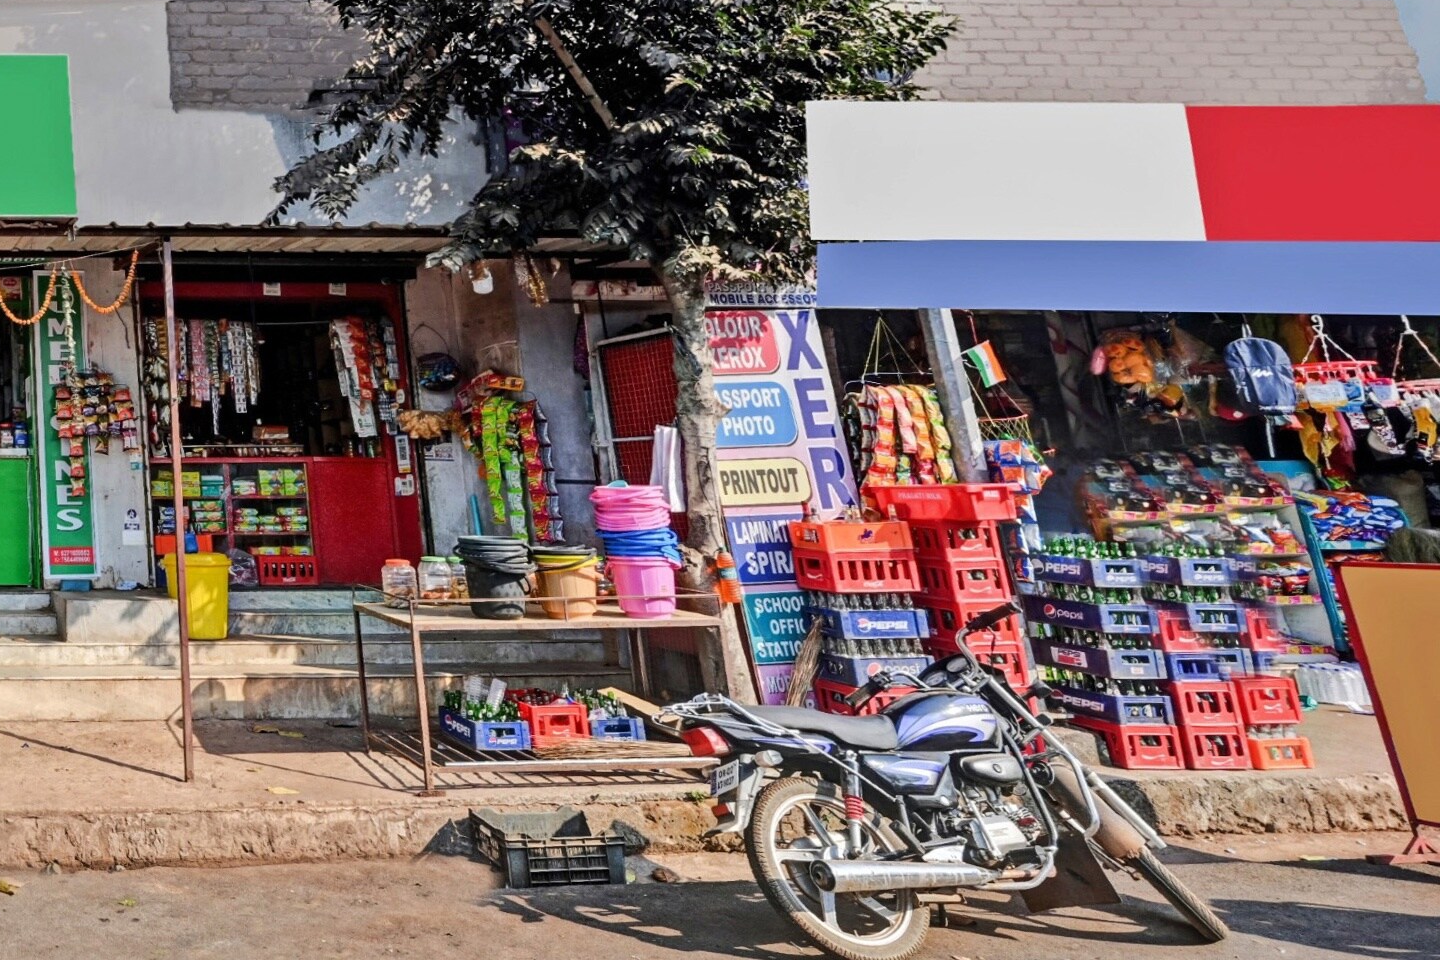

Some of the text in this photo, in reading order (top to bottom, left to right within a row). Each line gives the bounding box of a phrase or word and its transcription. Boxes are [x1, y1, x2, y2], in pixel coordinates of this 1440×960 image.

[709, 293, 755, 305] MOBILE
[721, 415, 776, 437] PHOTO
[720, 467, 800, 496] PRINTOUT
[731, 519, 790, 545] LAMINAT
[1044, 562, 1082, 576] PEPSI
[1056, 609, 1085, 622] pepsi
[868, 620, 909, 630] PEPSI
[1062, 694, 1106, 713] PEPSI
[450, 719, 471, 738] PEPSI
[496, 737, 518, 746] PEPSI
